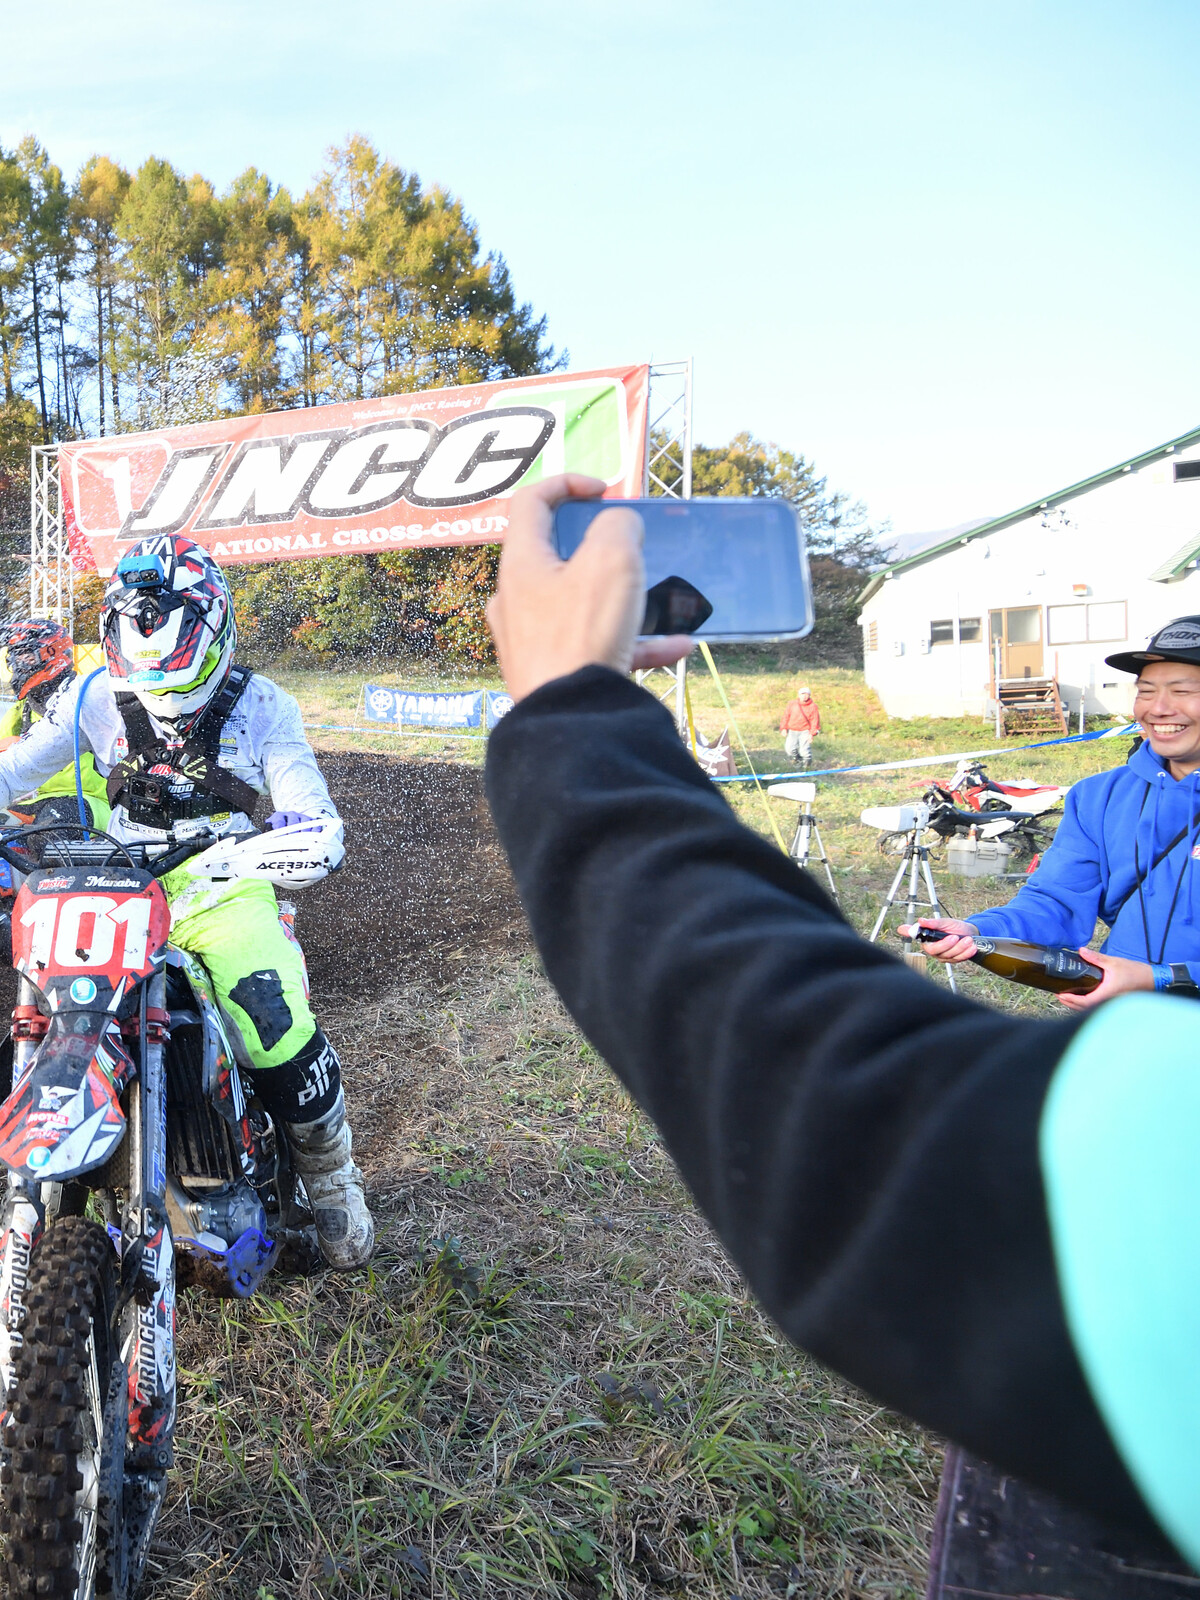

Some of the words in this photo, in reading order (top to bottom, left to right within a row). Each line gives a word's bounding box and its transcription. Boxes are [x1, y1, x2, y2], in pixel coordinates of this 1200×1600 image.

[397, 406, 408, 415] to
[409, 401, 437, 414] JNCC
[116, 406, 557, 540] JNCC
[206, 532, 328, 557] ATIONAL
[331, 516, 510, 547] CROSS-COUN
[1159, 630, 1200, 641] THOR
[394, 693, 474, 716] YAMAHA
[256, 861, 323, 870] ACERBIS
[85, 876, 141, 889] Manabu
[19, 895, 153, 971] 101
[28, 1112, 67, 1124] MOTUL
